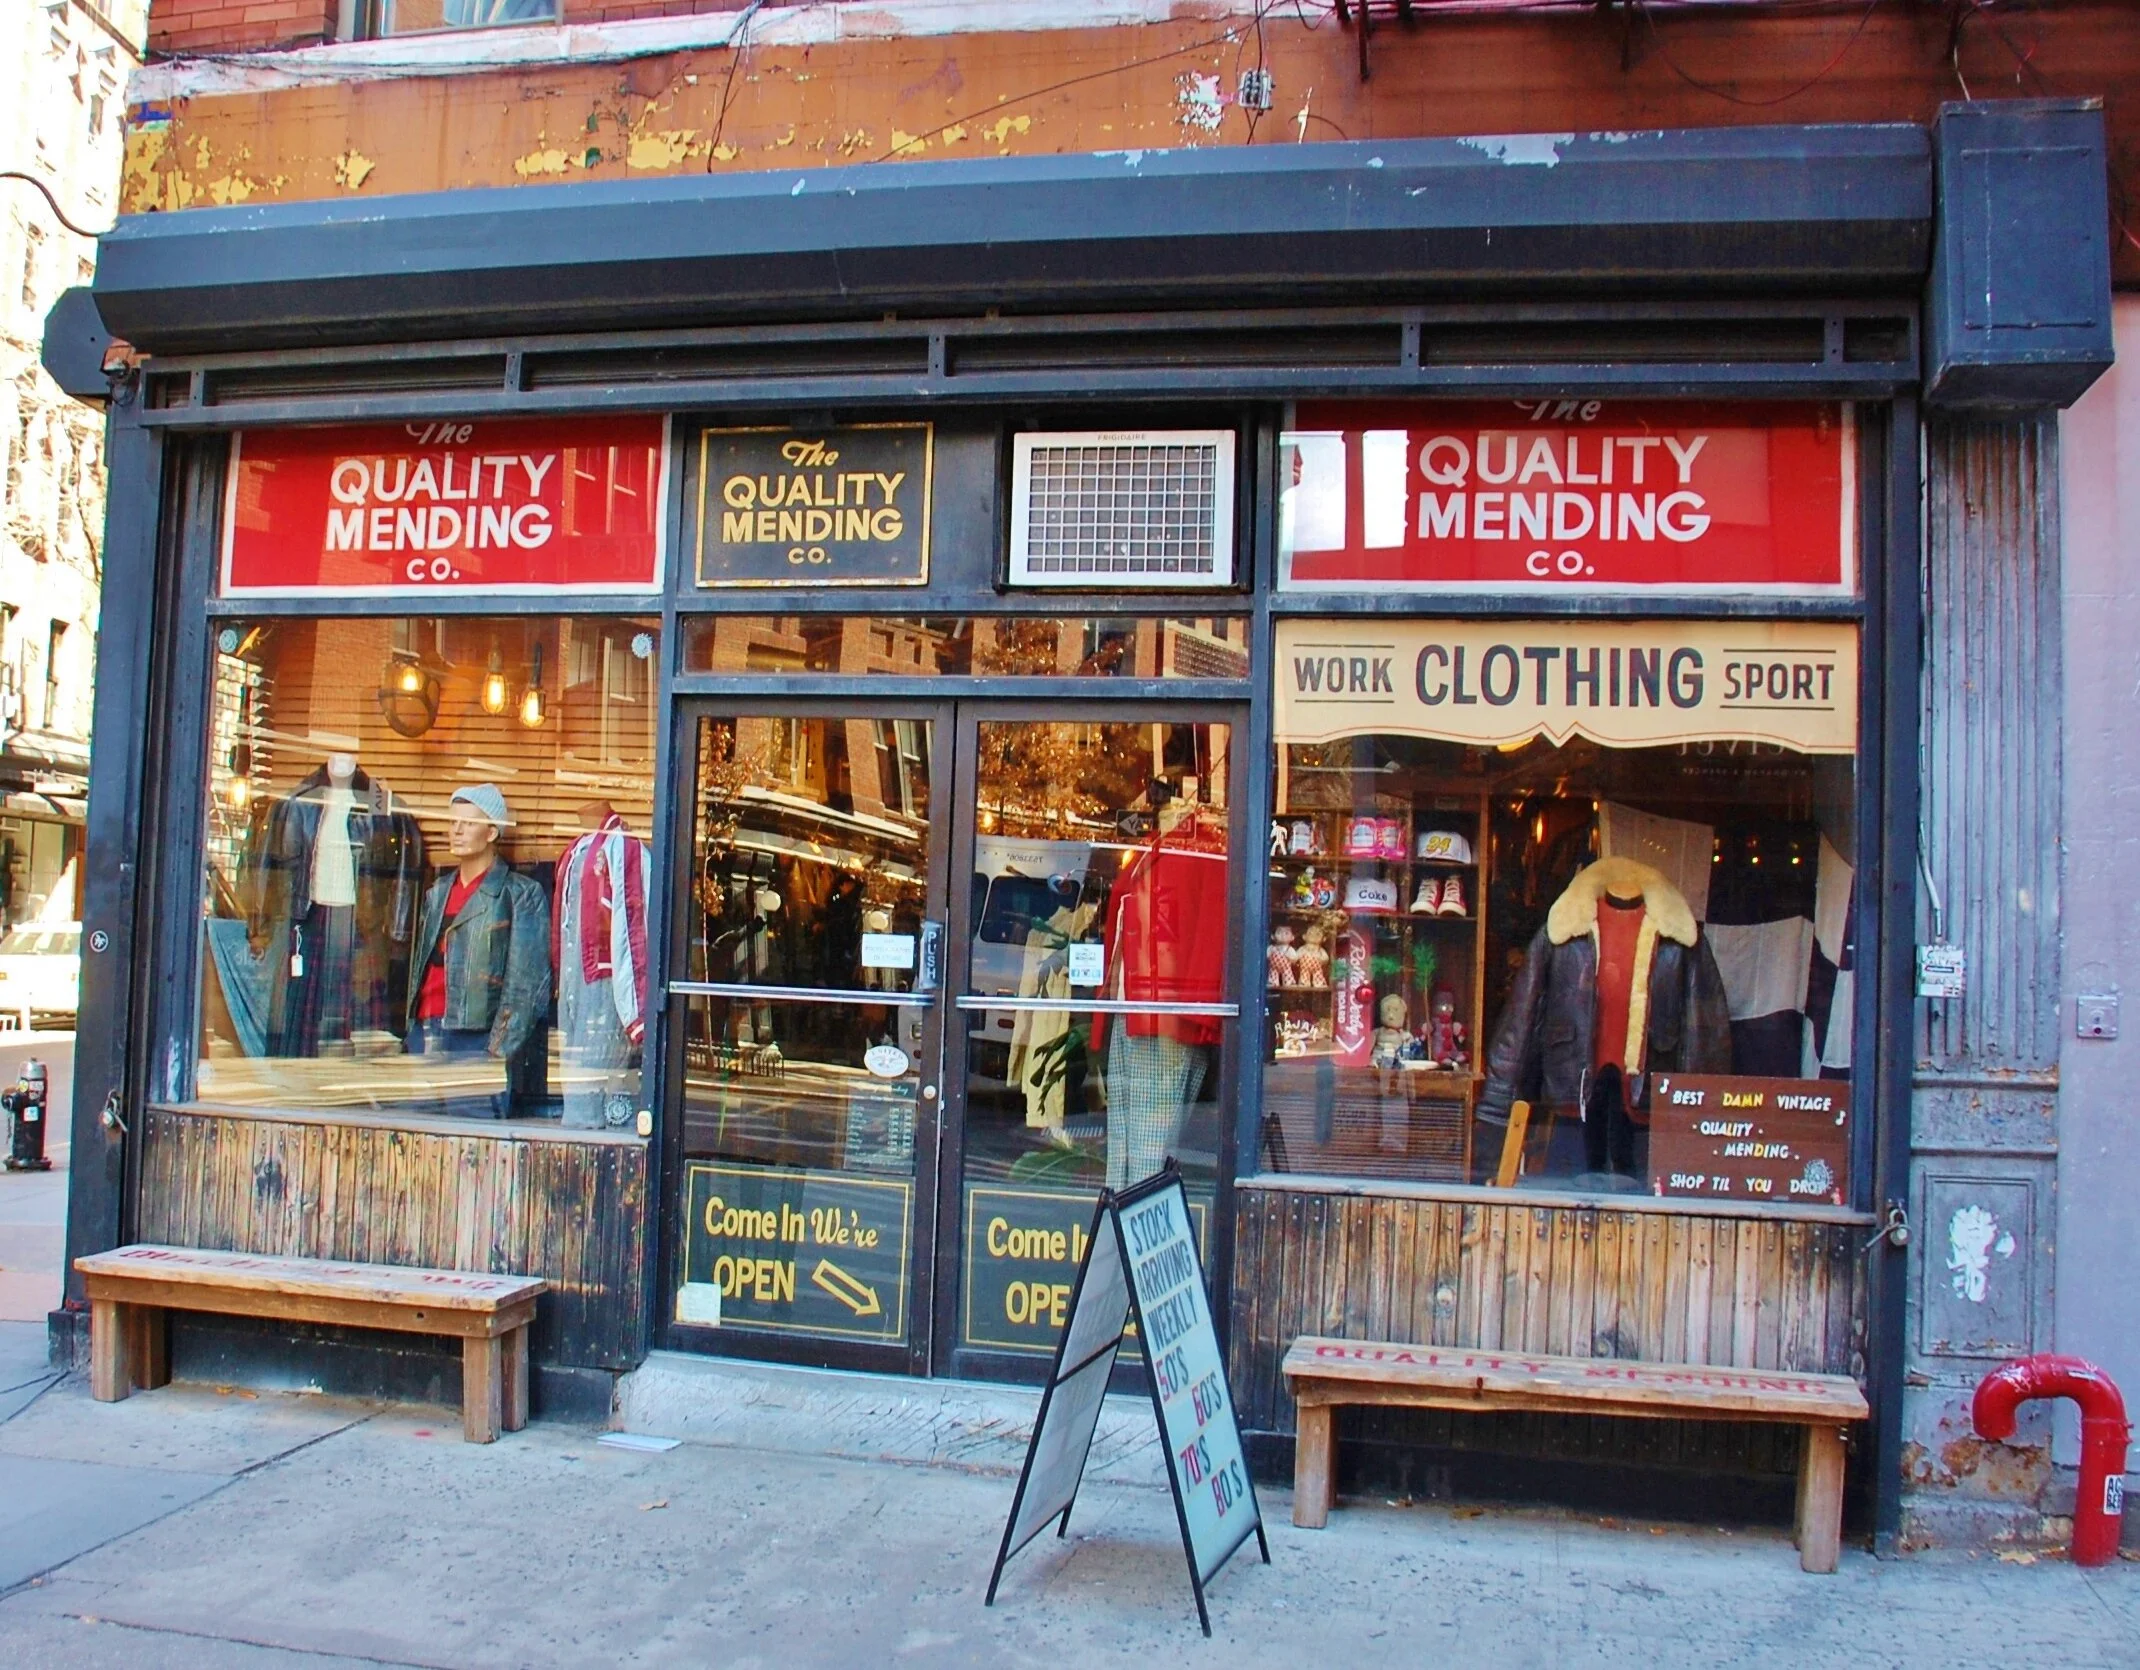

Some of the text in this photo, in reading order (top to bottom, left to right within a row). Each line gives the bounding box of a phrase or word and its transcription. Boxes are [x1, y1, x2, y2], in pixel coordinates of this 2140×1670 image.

[405, 422, 473, 445] The
[782, 440, 840, 468] The
[1098, 433, 1147, 441] FRIGIDAIRE
[330, 454, 556, 504] QUALITY
[1419, 434, 1709, 488] QUALITY
[723, 471, 905, 508] QUALITY
[325, 503, 553, 552] MENDING
[721, 508, 904, 543] MENDING
[1417, 491, 1712, 543] MENDING
[406, 557, 460, 582] CO.
[787, 547, 832, 565] CO.
[1525, 551, 1595, 577] CO.
[1294, 643, 1836, 709] WORK CLOTHING SPORT
[1426, 835, 1452, 853] 24
[1358, 889, 1388, 902] Coke
[927, 933, 937, 979] PUSH
[1673, 1091, 1832, 1111] BEST DAMN VINTAGE
[1701, 1122, 1753, 1136] QUALITY
[1725, 1144, 1788, 1159] MENDING
[1671, 1175, 1705, 1189] SHOP
[1713, 1178, 1730, 1191] TIL
[1746, 1180, 1772, 1193] YOU
[705, 1196, 879, 1248] Come In We're
[988, 1216, 1067, 1261] Come
[1130, 1198, 1176, 1257] STOCK
[714, 1254, 796, 1303] OPEN
[1136, 1238, 1193, 1304] ARRIVING
[1005, 1280, 1073, 1327] OPE
[1147, 1284, 1199, 1352] WEEKLY
[1155, 1345, 1190, 1403] 50'S
[1314, 1344, 1549, 1374] QUALITY
[1191, 1371, 1223, 1428] 60'S
[1179, 1434, 1212, 1494] 70'S
